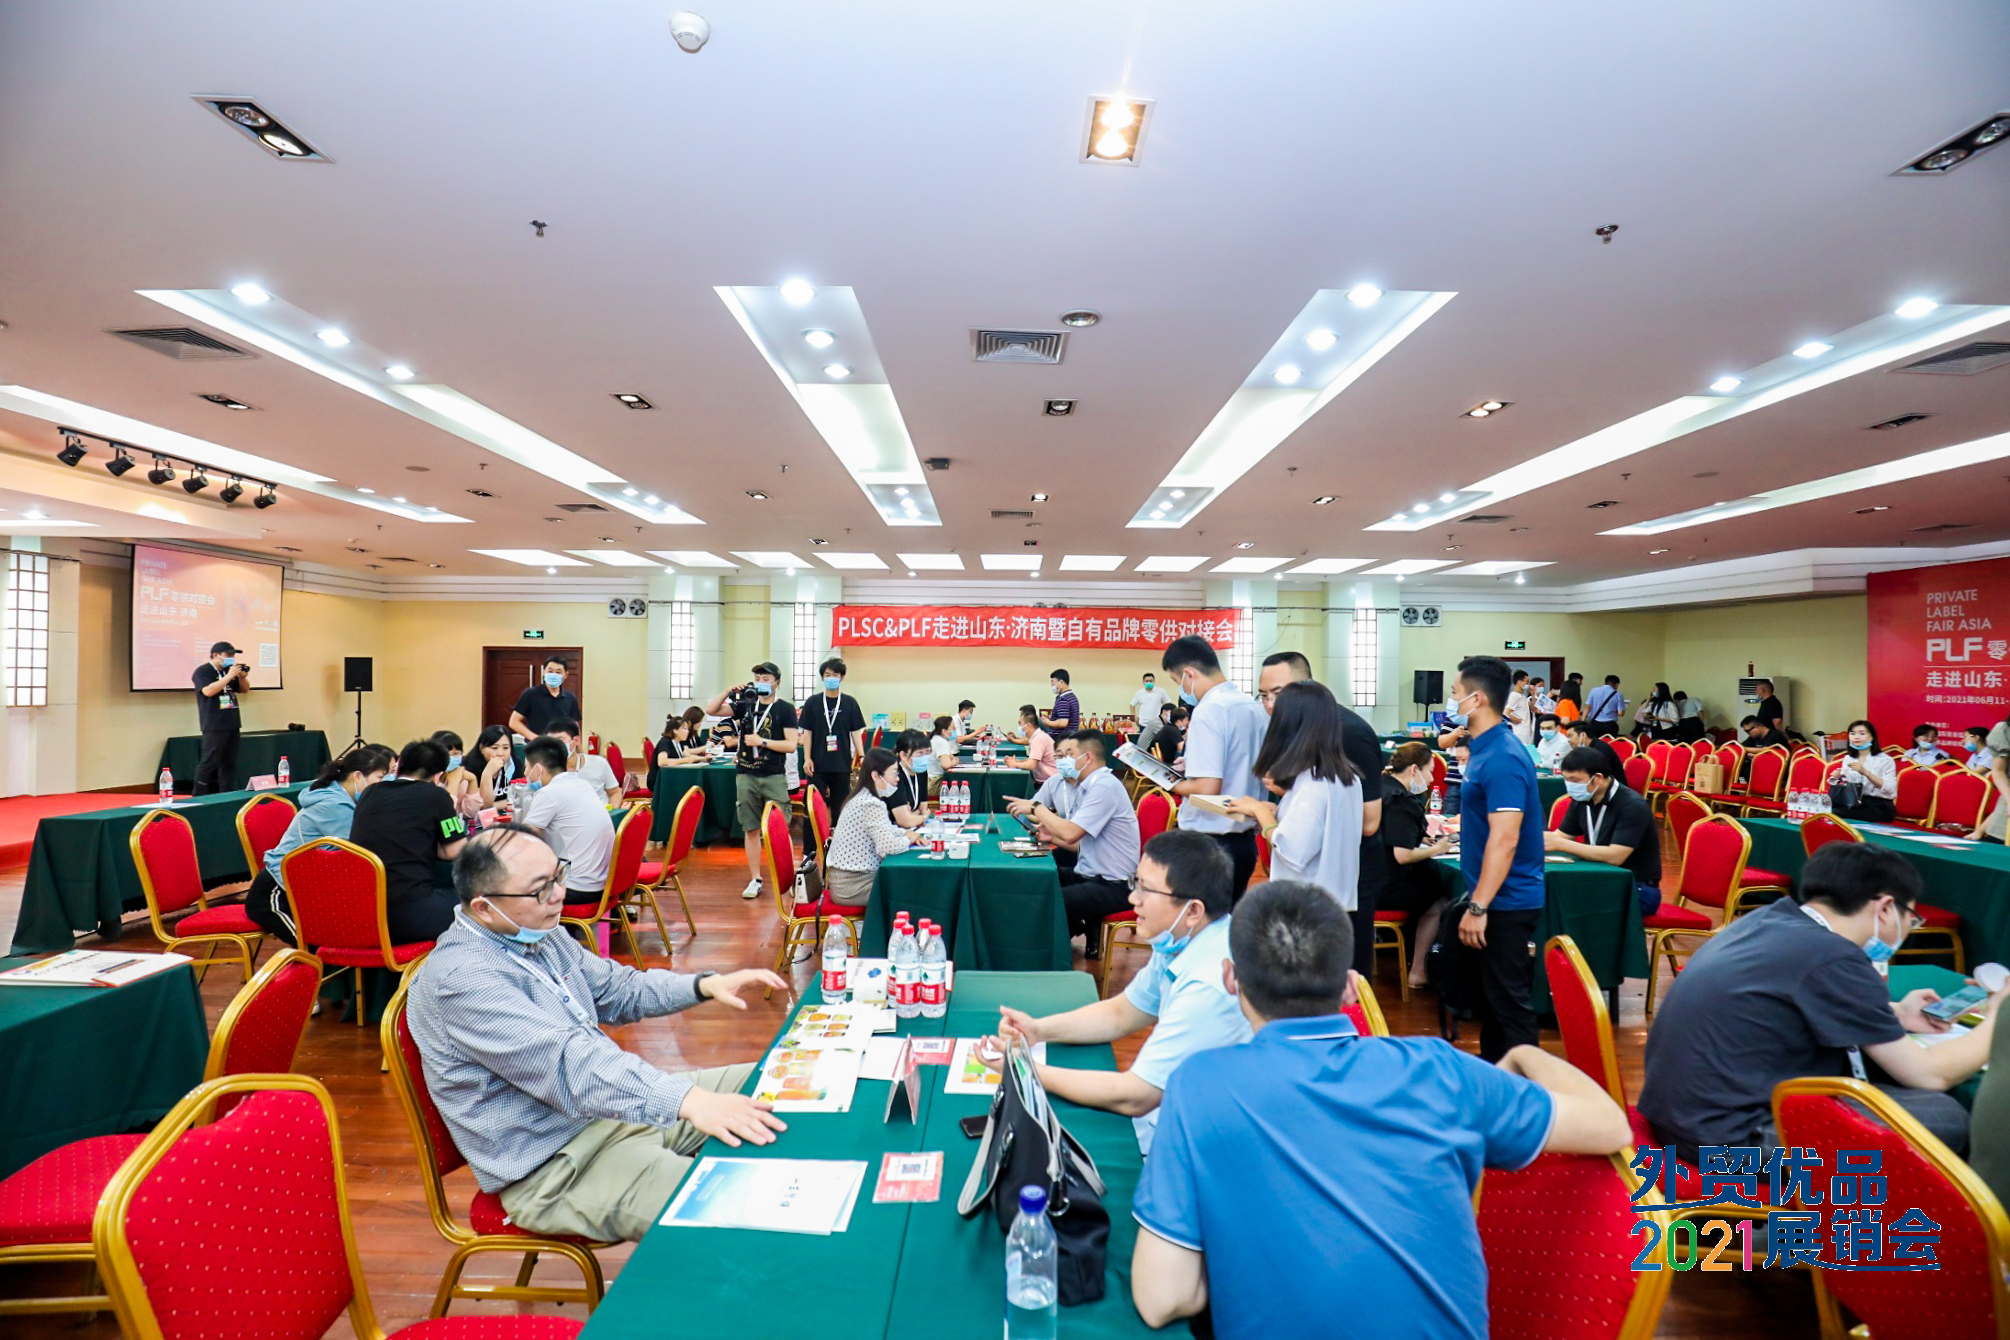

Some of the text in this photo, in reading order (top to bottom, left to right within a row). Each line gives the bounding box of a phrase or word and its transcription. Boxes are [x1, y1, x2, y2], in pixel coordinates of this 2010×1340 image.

[140, 586, 169, 601] PLF
[1926, 589, 1978, 604] PRIVATE
[1926, 605, 1965, 618] LABEL
[838, 615, 1233, 643] PLSC&PLF走进山东·济南暨自有品牌零供对接会
[1926, 617, 1992, 632] FAIR ASIA
[1926, 637, 2010, 662] PLF 零
